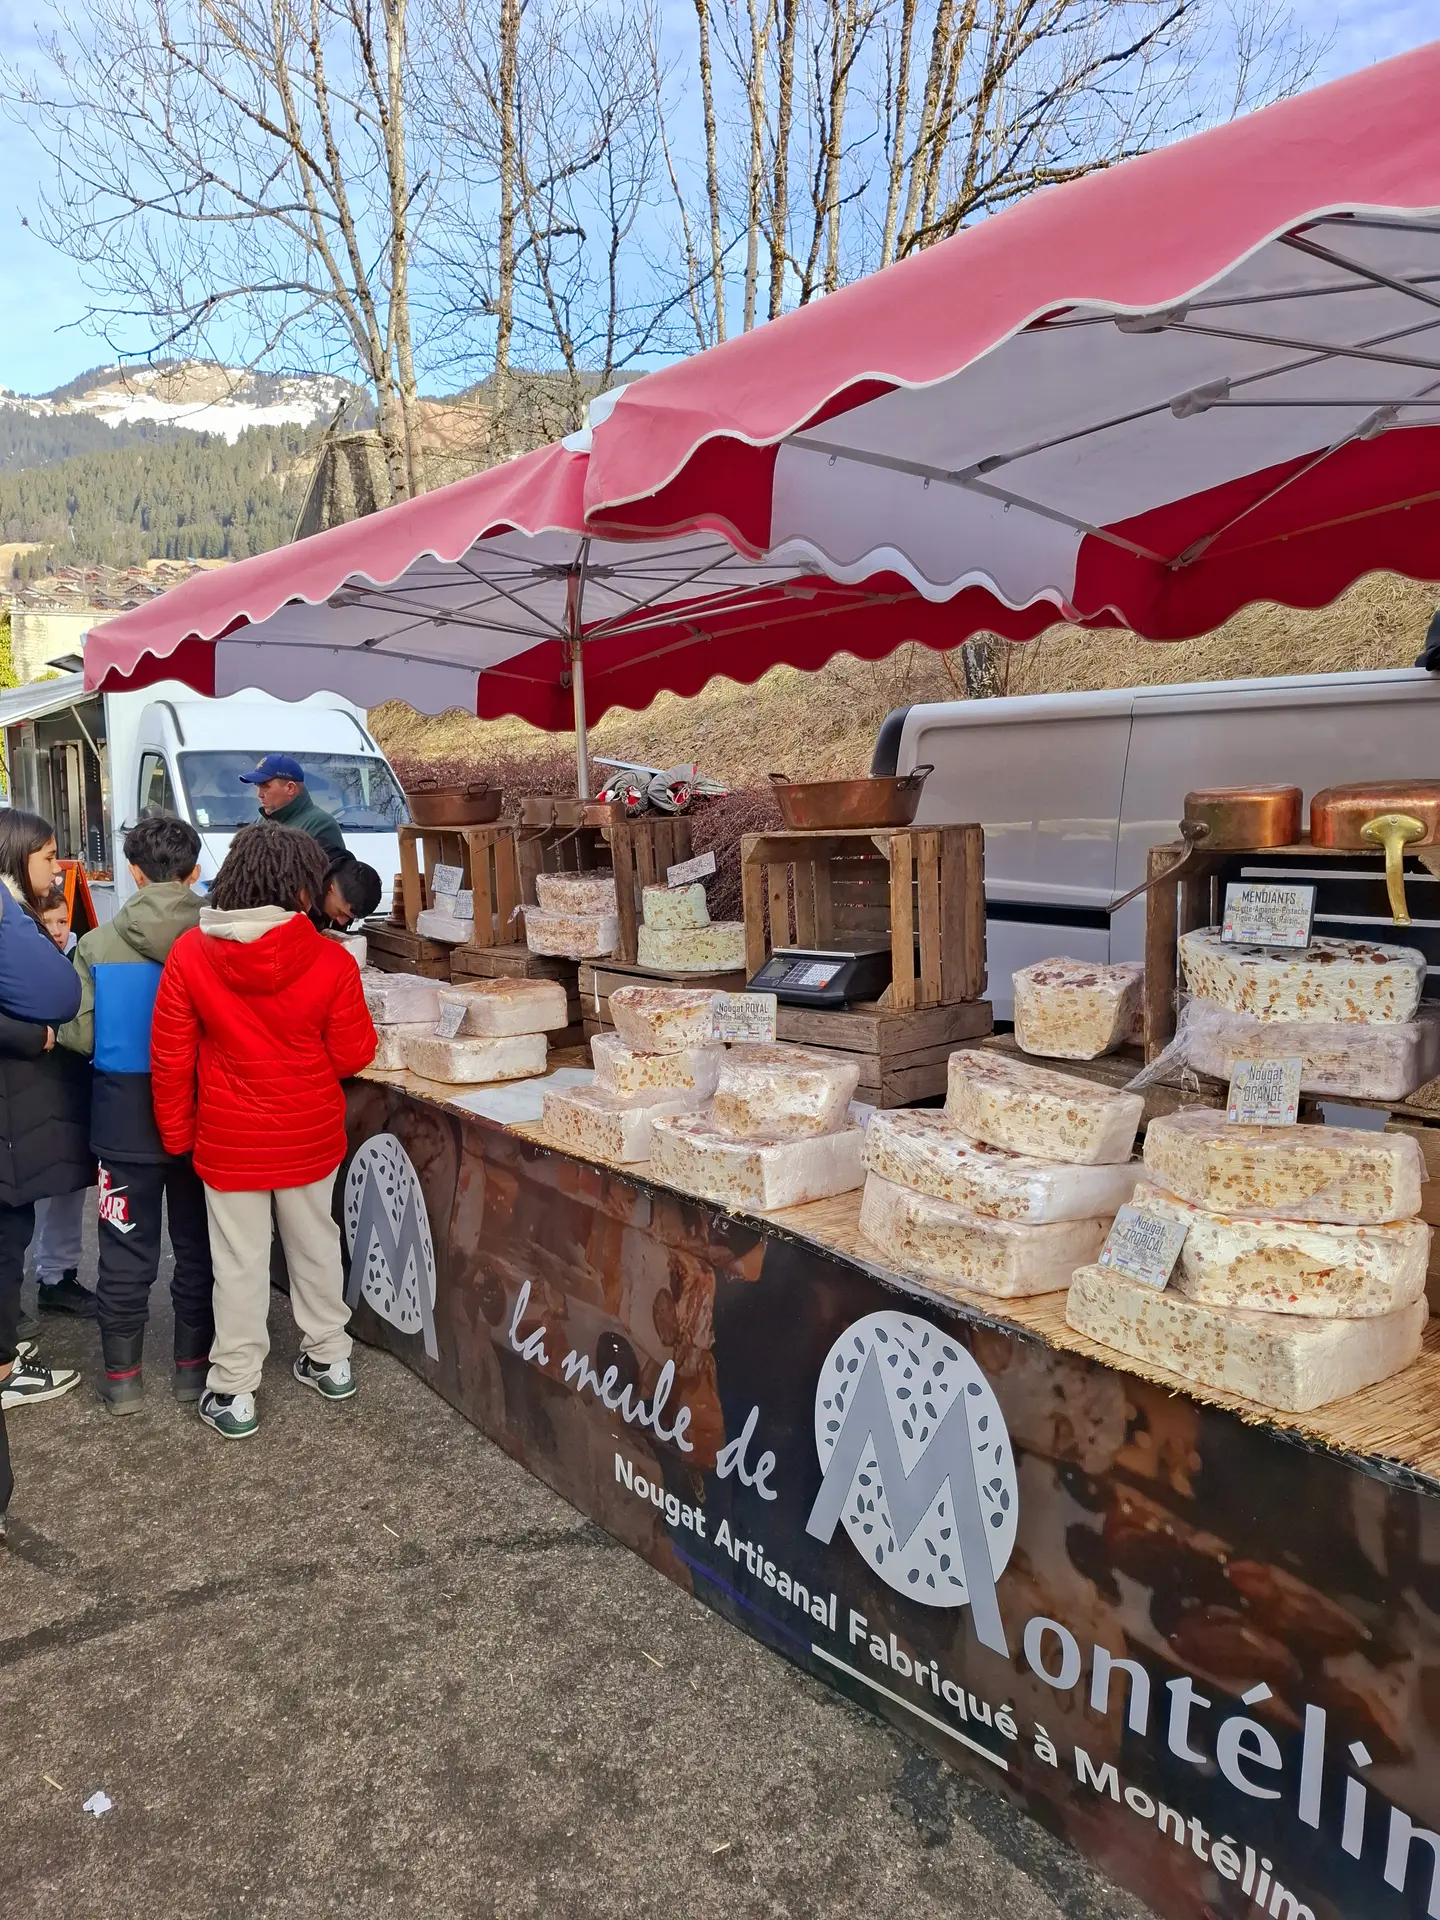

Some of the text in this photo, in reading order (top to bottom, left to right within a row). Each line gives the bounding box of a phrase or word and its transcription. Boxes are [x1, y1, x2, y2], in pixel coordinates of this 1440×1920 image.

[1241, 890, 1297, 905] MENDIANTS
[718, 1002, 768, 1014] Nougat ROYAL
[1248, 1065, 1284, 1083] Nougat
[1243, 1085, 1283, 1102] ORANGE
[1134, 1215, 1166, 1236] Nougat
[1122, 1228, 1164, 1255] TROPICAL
[508, 1279, 549, 1366] la
[561, 1359, 694, 1452] meule
[716, 1405, 778, 1501] de
[614, 1452, 706, 1538] Nougat
[713, 1518, 837, 1632] Artisanal
[848, 1608, 1019, 1741] Fabriqué
[1033, 1721, 1059, 1768] à
